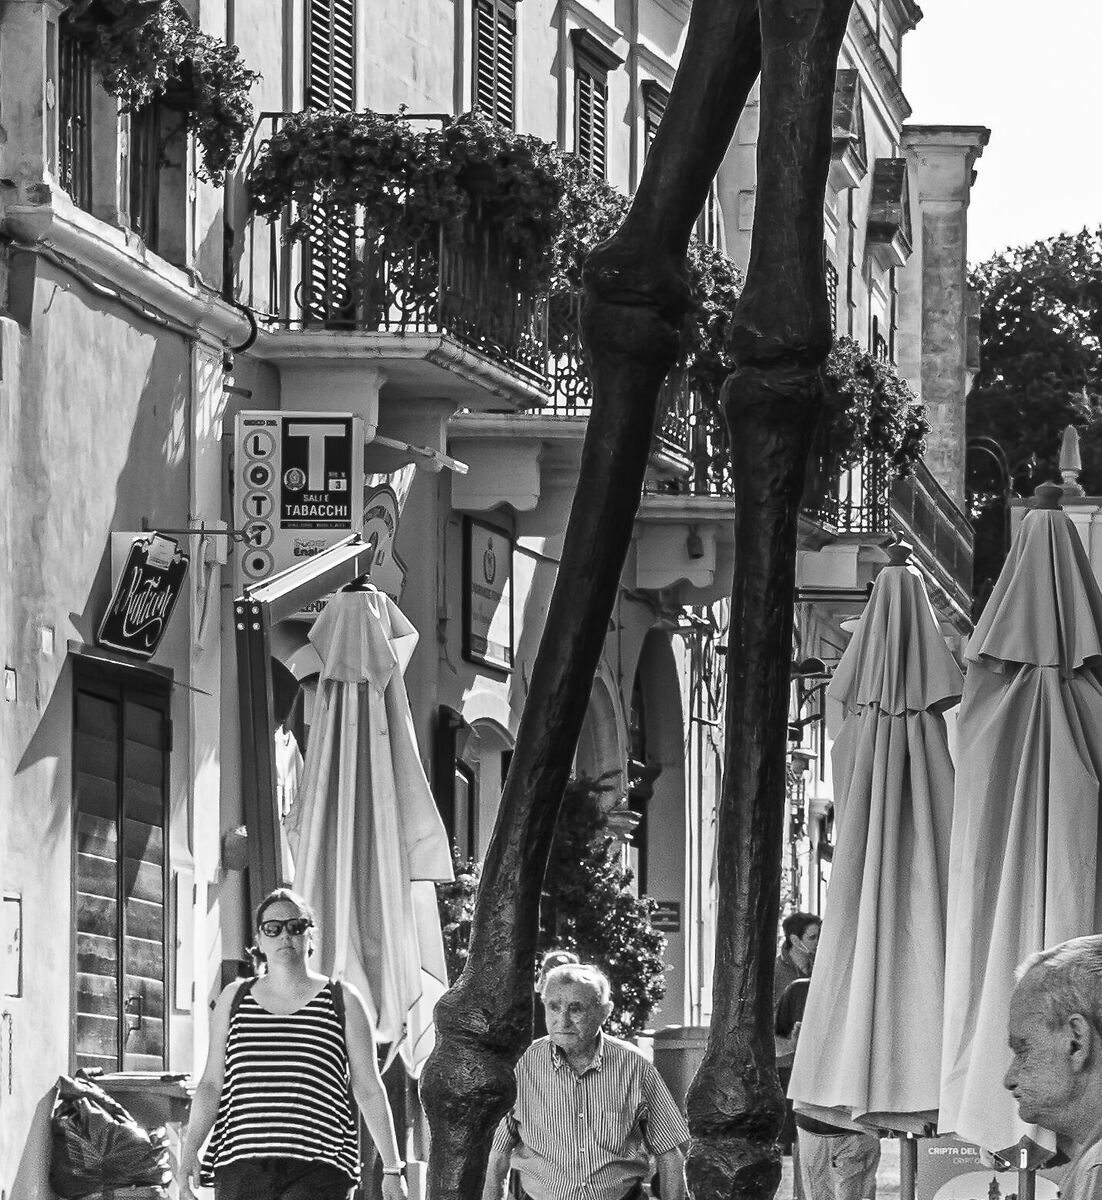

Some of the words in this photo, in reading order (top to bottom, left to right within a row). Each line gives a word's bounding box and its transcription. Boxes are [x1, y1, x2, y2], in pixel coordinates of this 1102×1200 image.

[288, 423, 346, 491] T
[335, 480, 342, 490] 3
[285, 504, 347, 517] TABACCHI
[927, 1147, 959, 1156] CRIPTA
[960, 1147, 978, 1156] DEL
